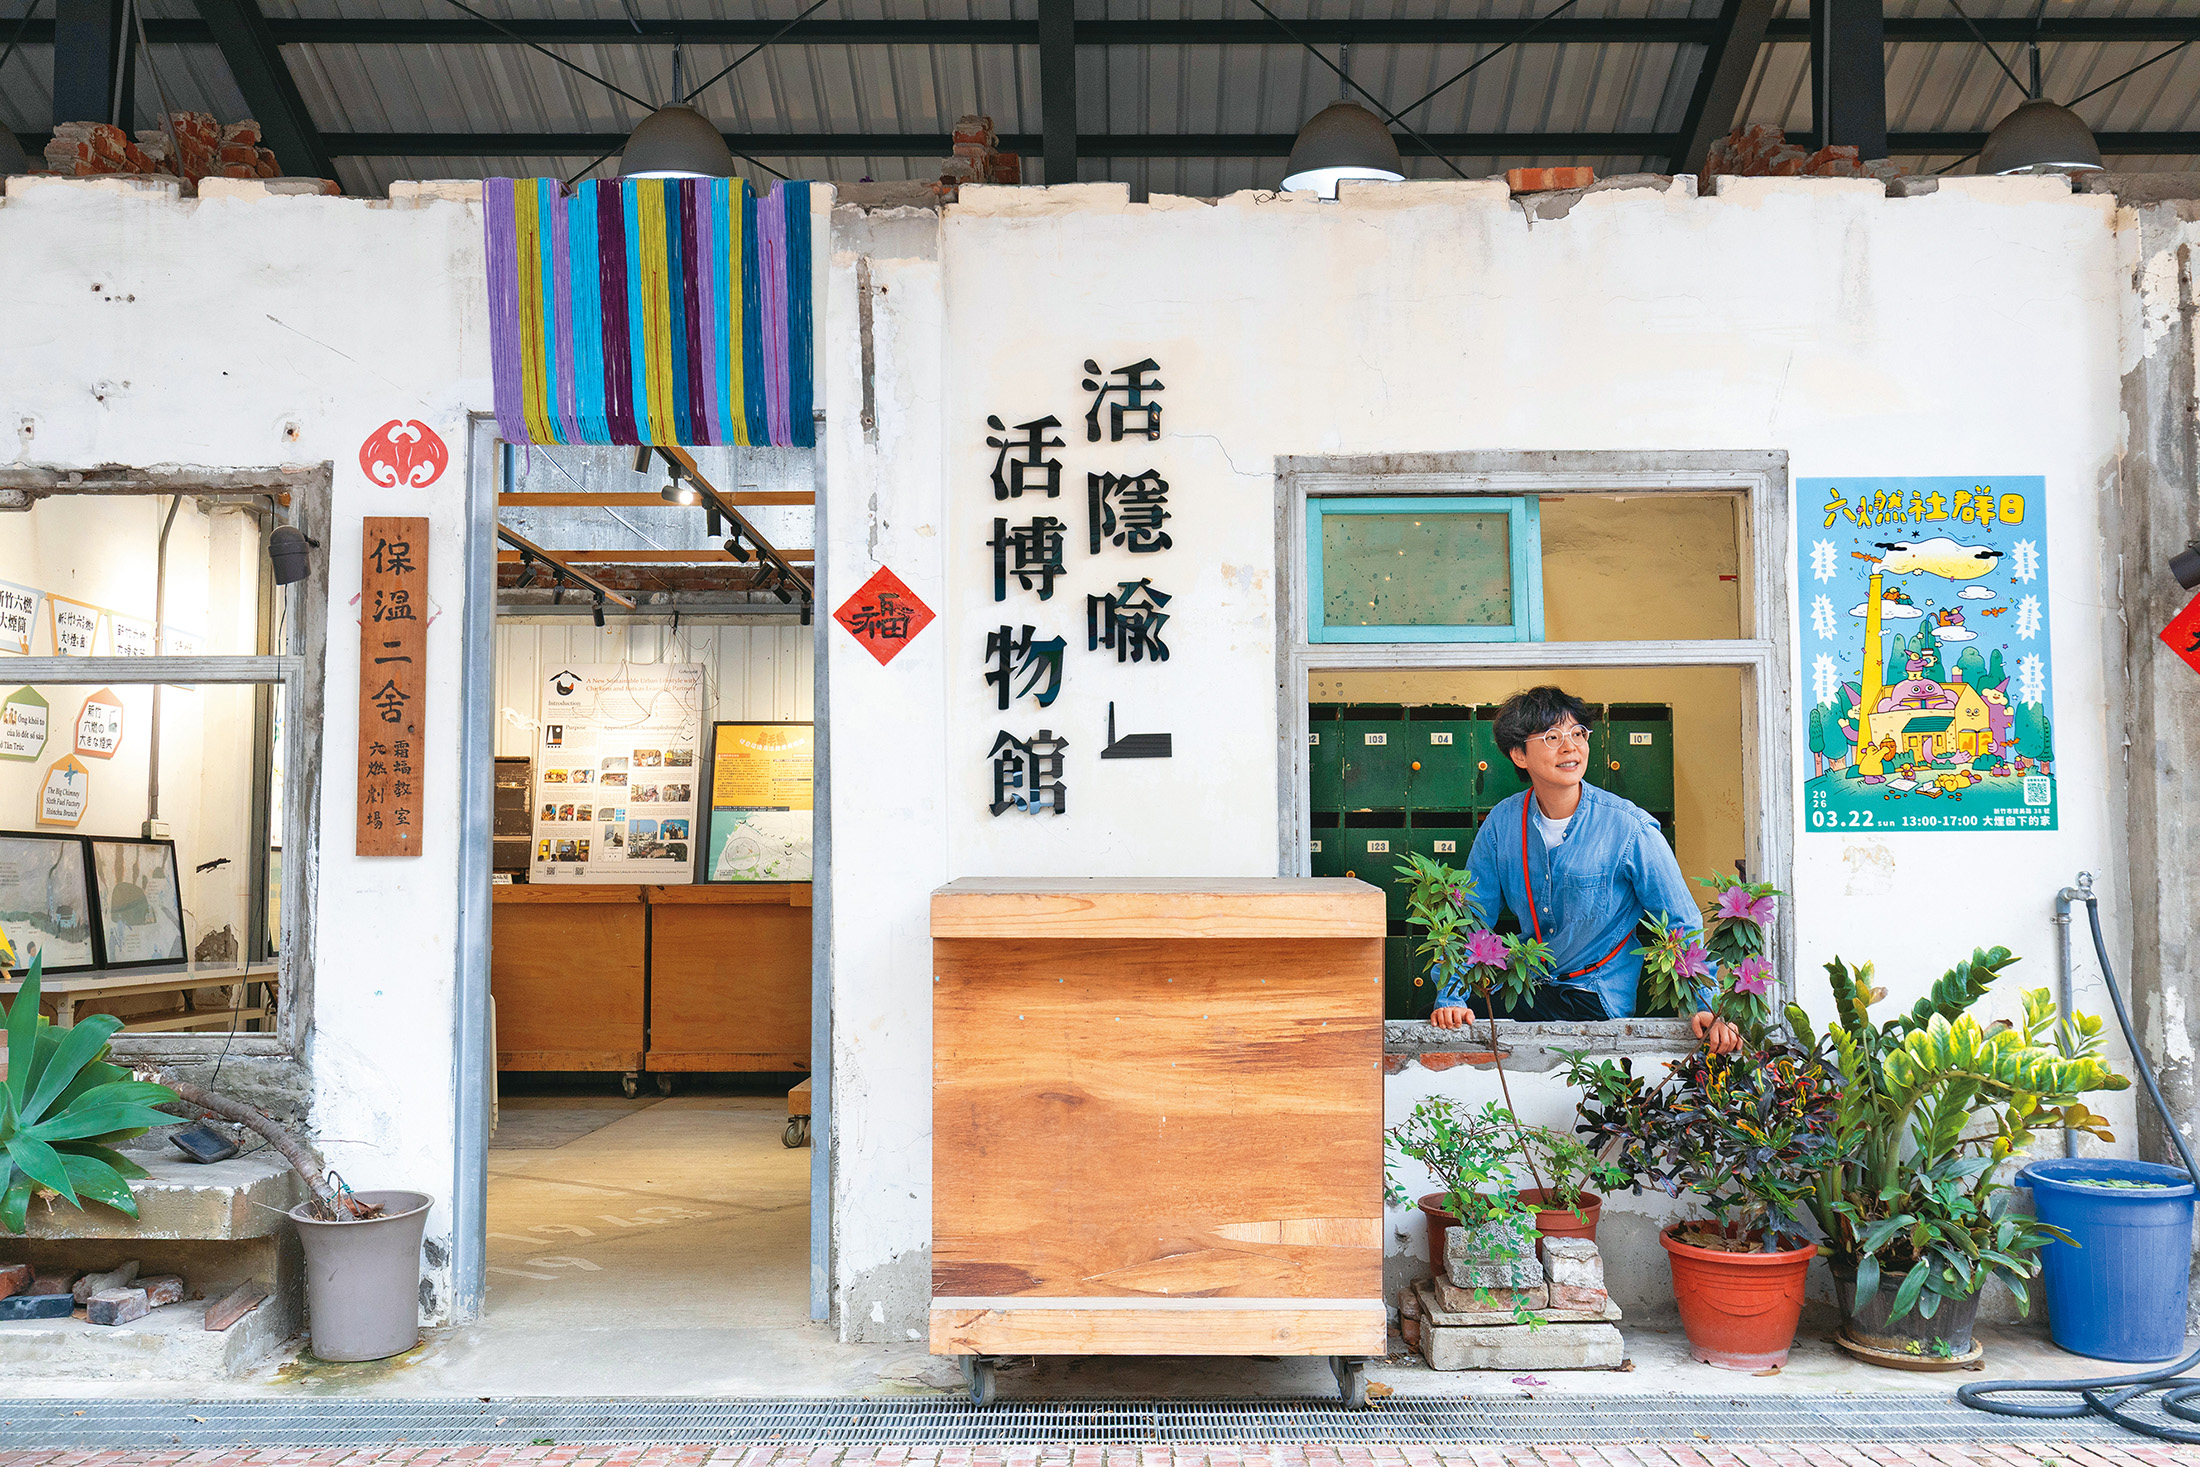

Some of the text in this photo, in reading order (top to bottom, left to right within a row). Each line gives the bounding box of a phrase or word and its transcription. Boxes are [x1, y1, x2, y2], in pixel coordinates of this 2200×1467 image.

[1082, 357, 1173, 663] 活隱喻
[1824, 485, 2025, 529] 六燃社群日
[841, 593, 916, 639] 福
[984, 415, 1069, 817] 活博物館
[1369, 735, 1384, 743] 103
[366, 741, 387, 830] 六燃劇場
[1813, 791, 1826, 799] 20
[1813, 800, 1827, 808] 26
[1813, 810, 1875, 827] 03.22
[1902, 815, 1978, 827] 13:00-17:00
[1371, 843, 1386, 851] 123
